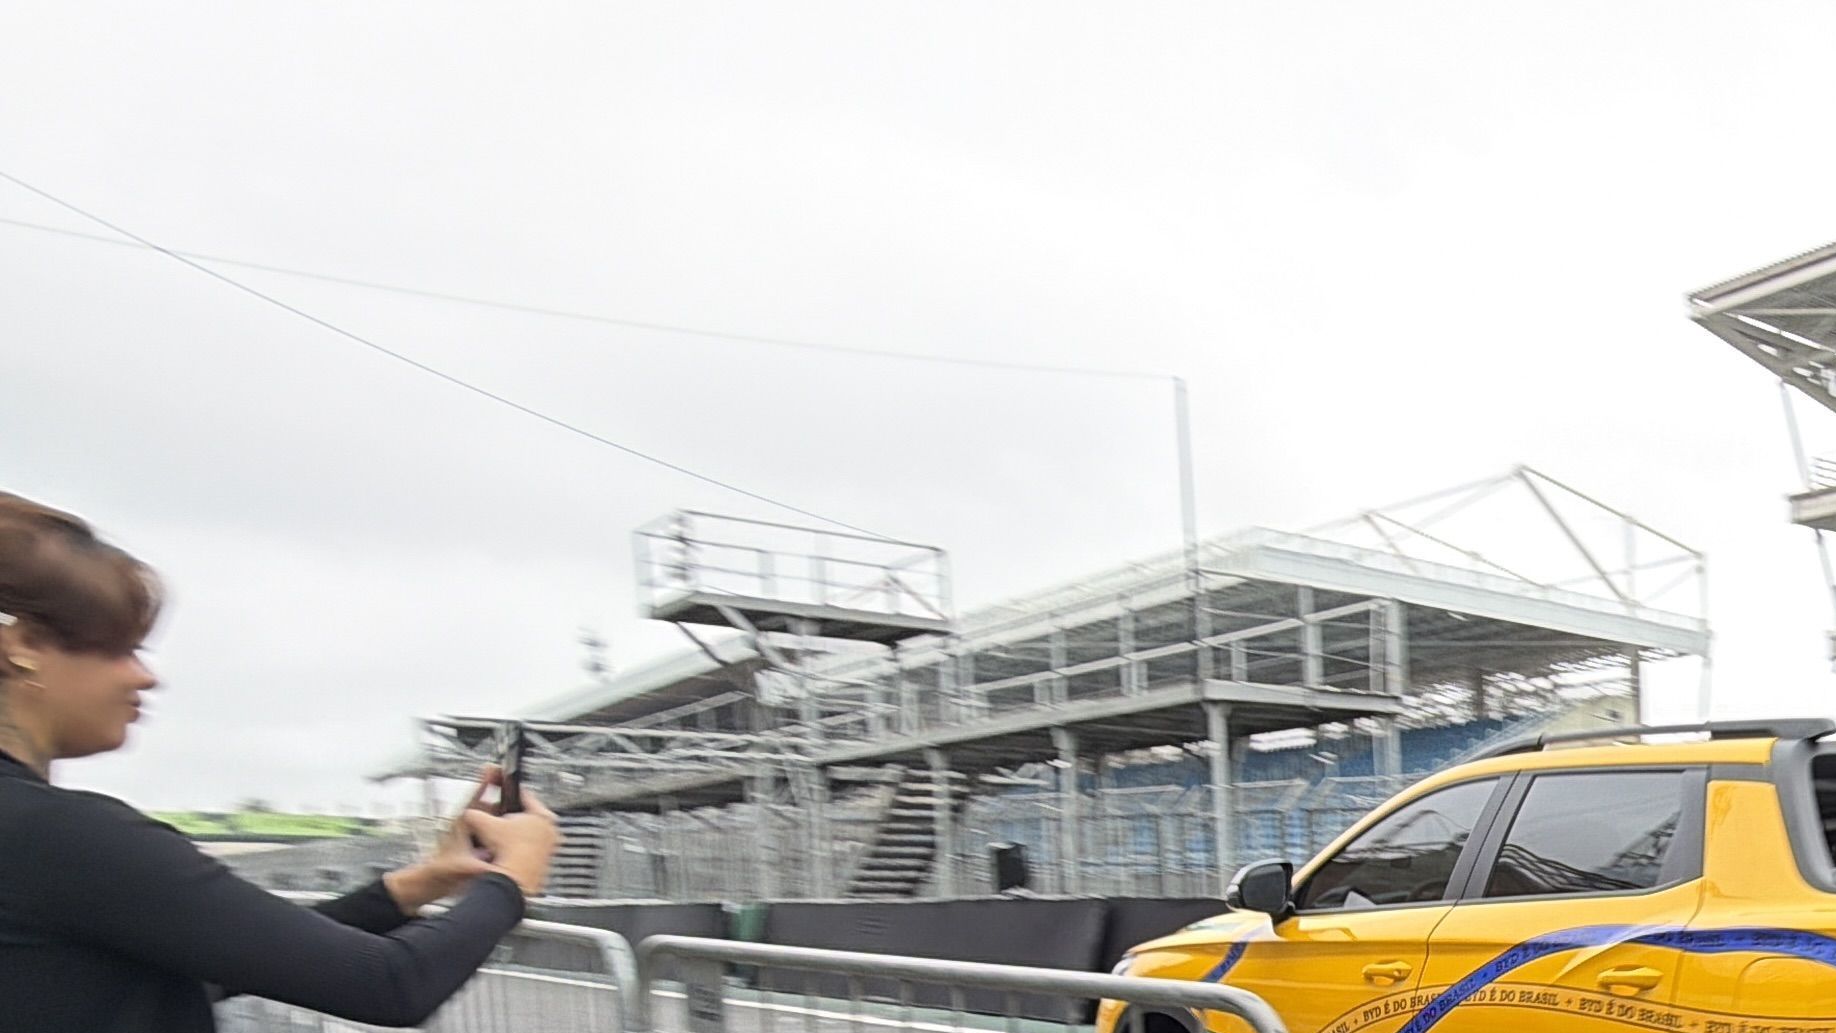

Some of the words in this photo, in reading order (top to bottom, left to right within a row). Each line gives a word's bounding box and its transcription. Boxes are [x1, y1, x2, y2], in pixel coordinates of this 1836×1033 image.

[1363, 1007, 1381, 1022] BYD
[1384, 1000, 1391, 1015] É
[1393, 999, 1407, 1013] DO
[1490, 987, 1497, 1000] É
[1501, 990, 1516, 1001] DO
[1519, 990, 1559, 1006] BRASIL
[1579, 997, 1604, 1013] BYD
[1606, 999, 1614, 1015] É
[1617, 1004, 1636, 1020] DO
[1638, 1008, 1682, 1028] BRASIL
[1422, 1007, 1437, 1023] DO
